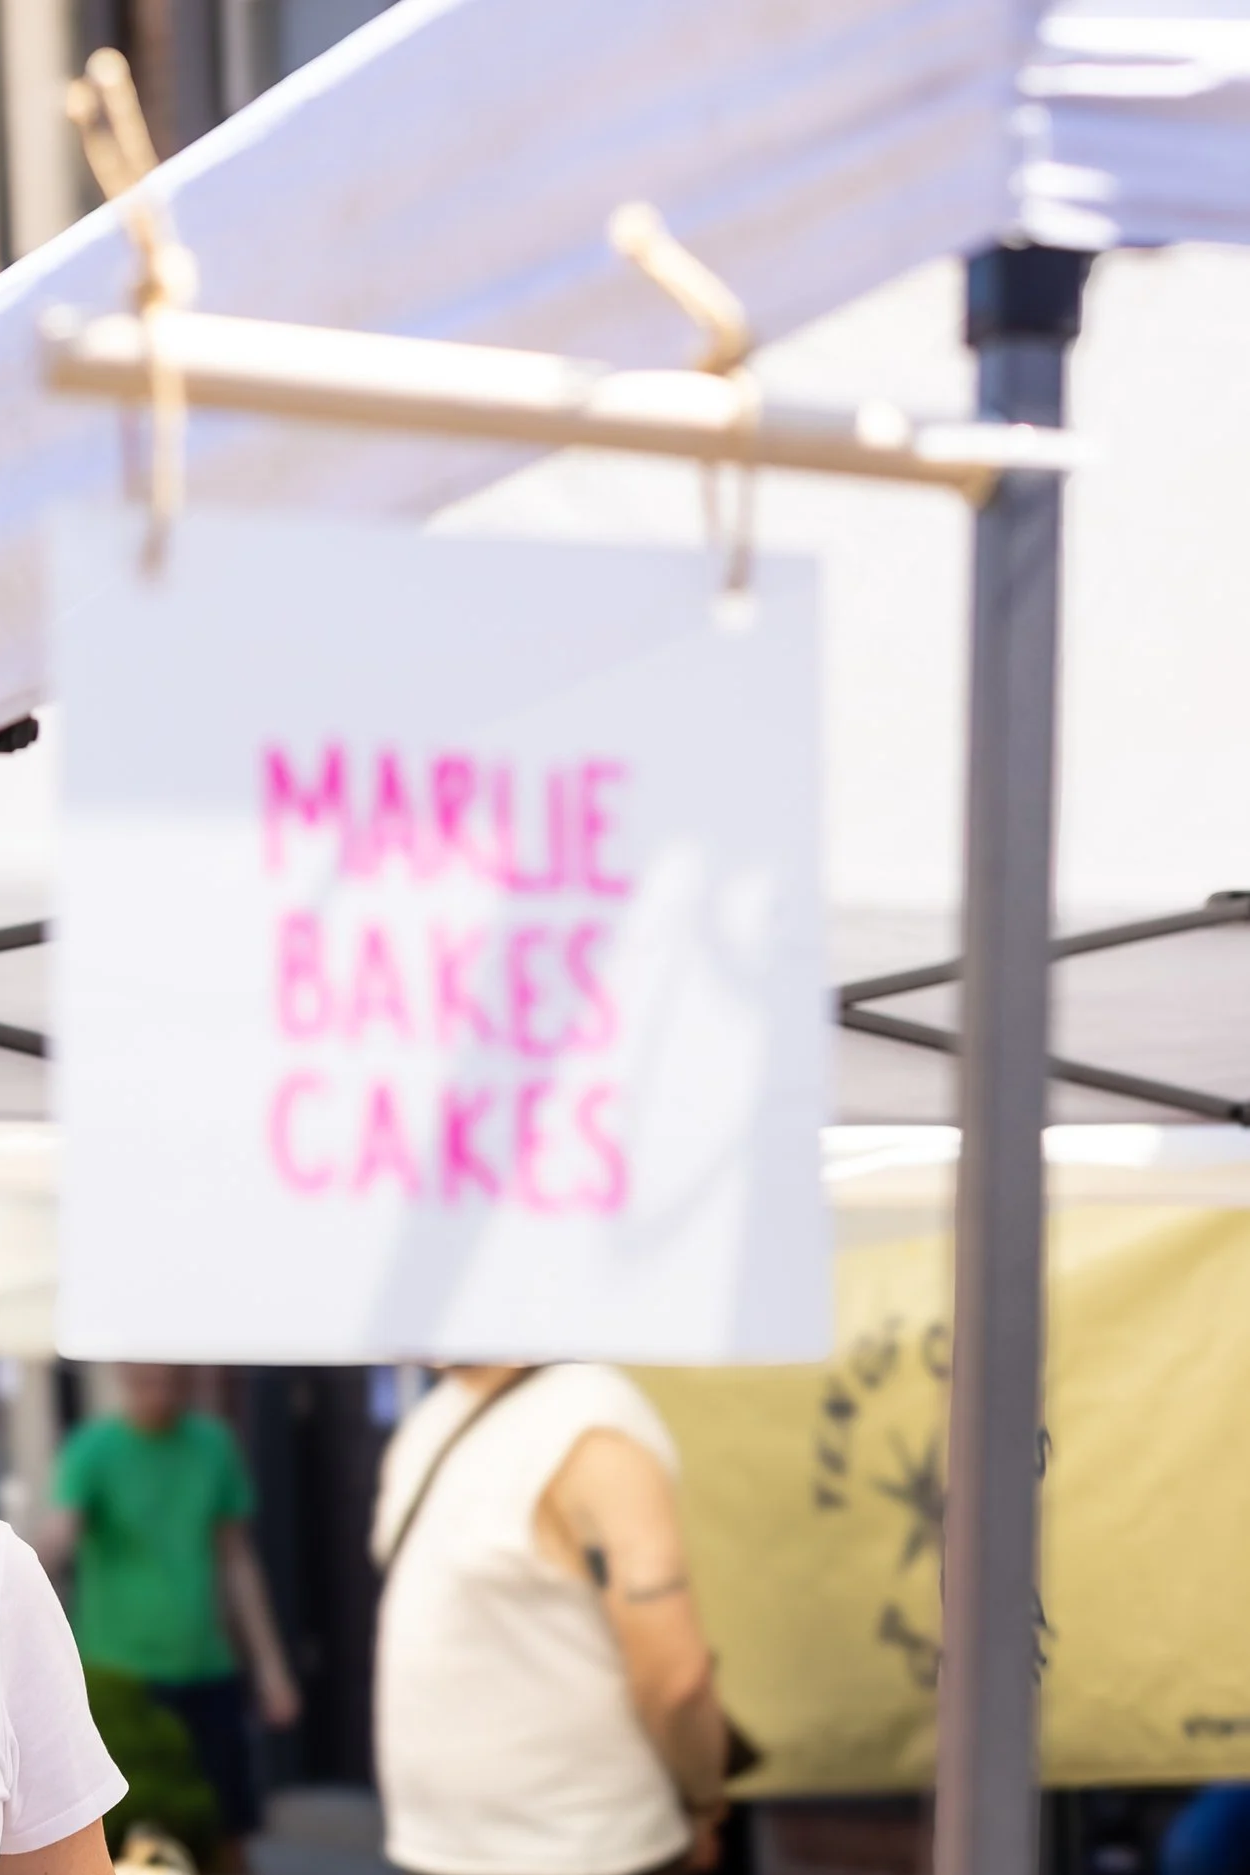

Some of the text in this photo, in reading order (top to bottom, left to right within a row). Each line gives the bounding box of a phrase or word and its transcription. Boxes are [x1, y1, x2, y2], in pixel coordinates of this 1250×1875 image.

[260, 742, 632, 893] MARLIE
[276, 908, 617, 1058] BAKES
[267, 1068, 630, 1216] CAKES
